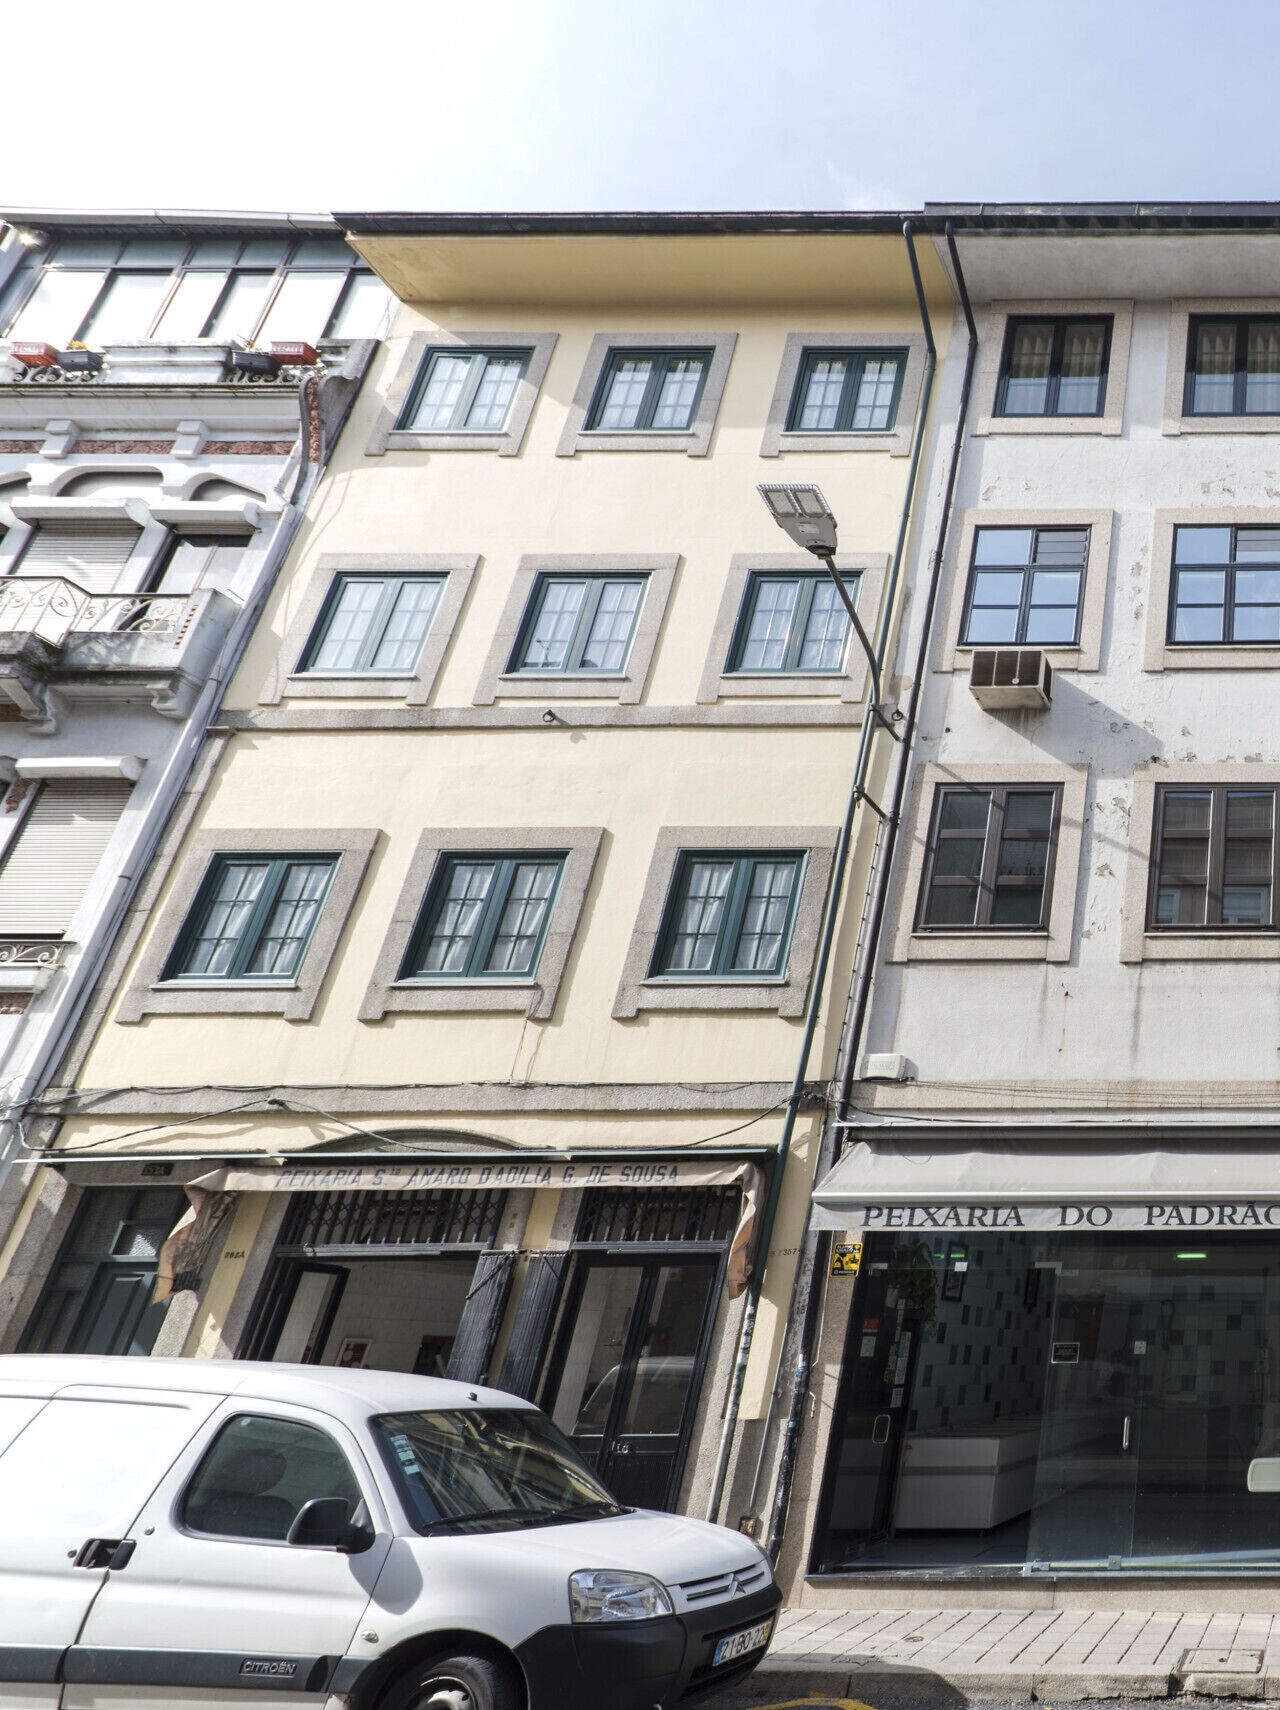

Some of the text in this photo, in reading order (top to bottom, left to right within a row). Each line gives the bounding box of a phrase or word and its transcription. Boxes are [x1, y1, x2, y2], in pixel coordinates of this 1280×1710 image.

[275, 1168, 363, 1189] PEIXARIA
[402, 1167, 472, 1189] AMARO
[584, 1164, 611, 1184] DE
[619, 1164, 679, 1184] SOUSA
[860, 1205, 1026, 1228] PEIXARIA
[1057, 1205, 1113, 1227] DO
[243, 1660, 296, 1674] CITROËN
